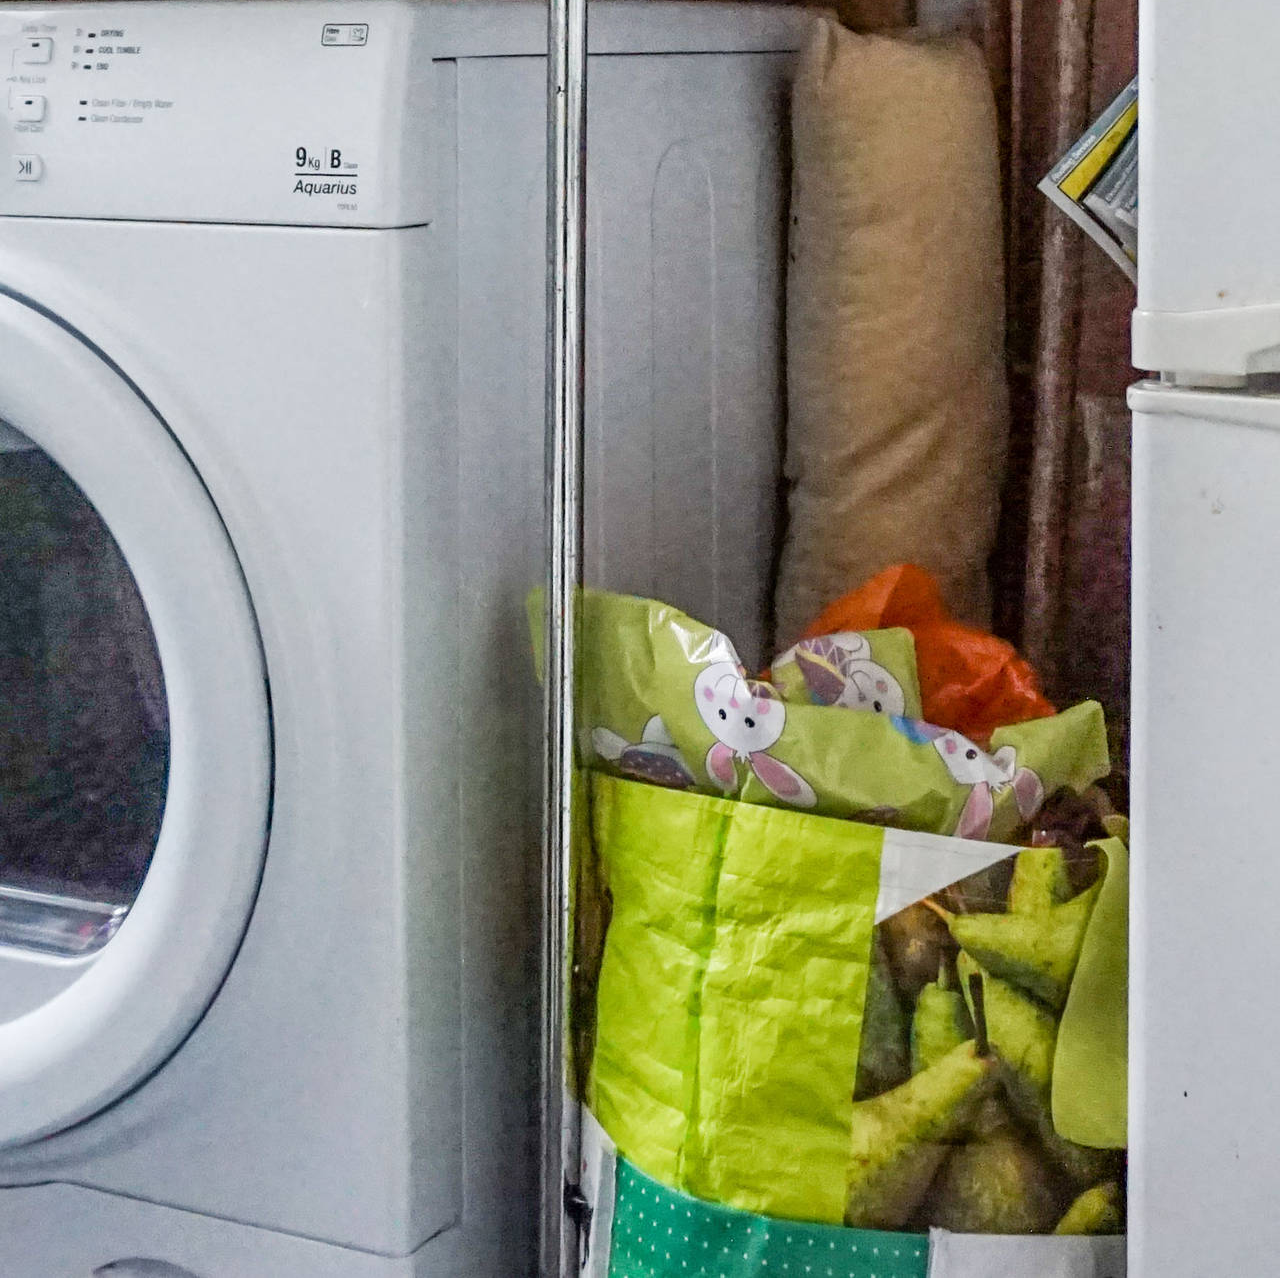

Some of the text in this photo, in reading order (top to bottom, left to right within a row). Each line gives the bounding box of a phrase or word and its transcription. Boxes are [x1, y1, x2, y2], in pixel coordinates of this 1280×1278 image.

[100, 28, 124, 38] DRYING
[295, 146, 342, 170] 9 Kg B
[293, 178, 358, 197] Aquarius
